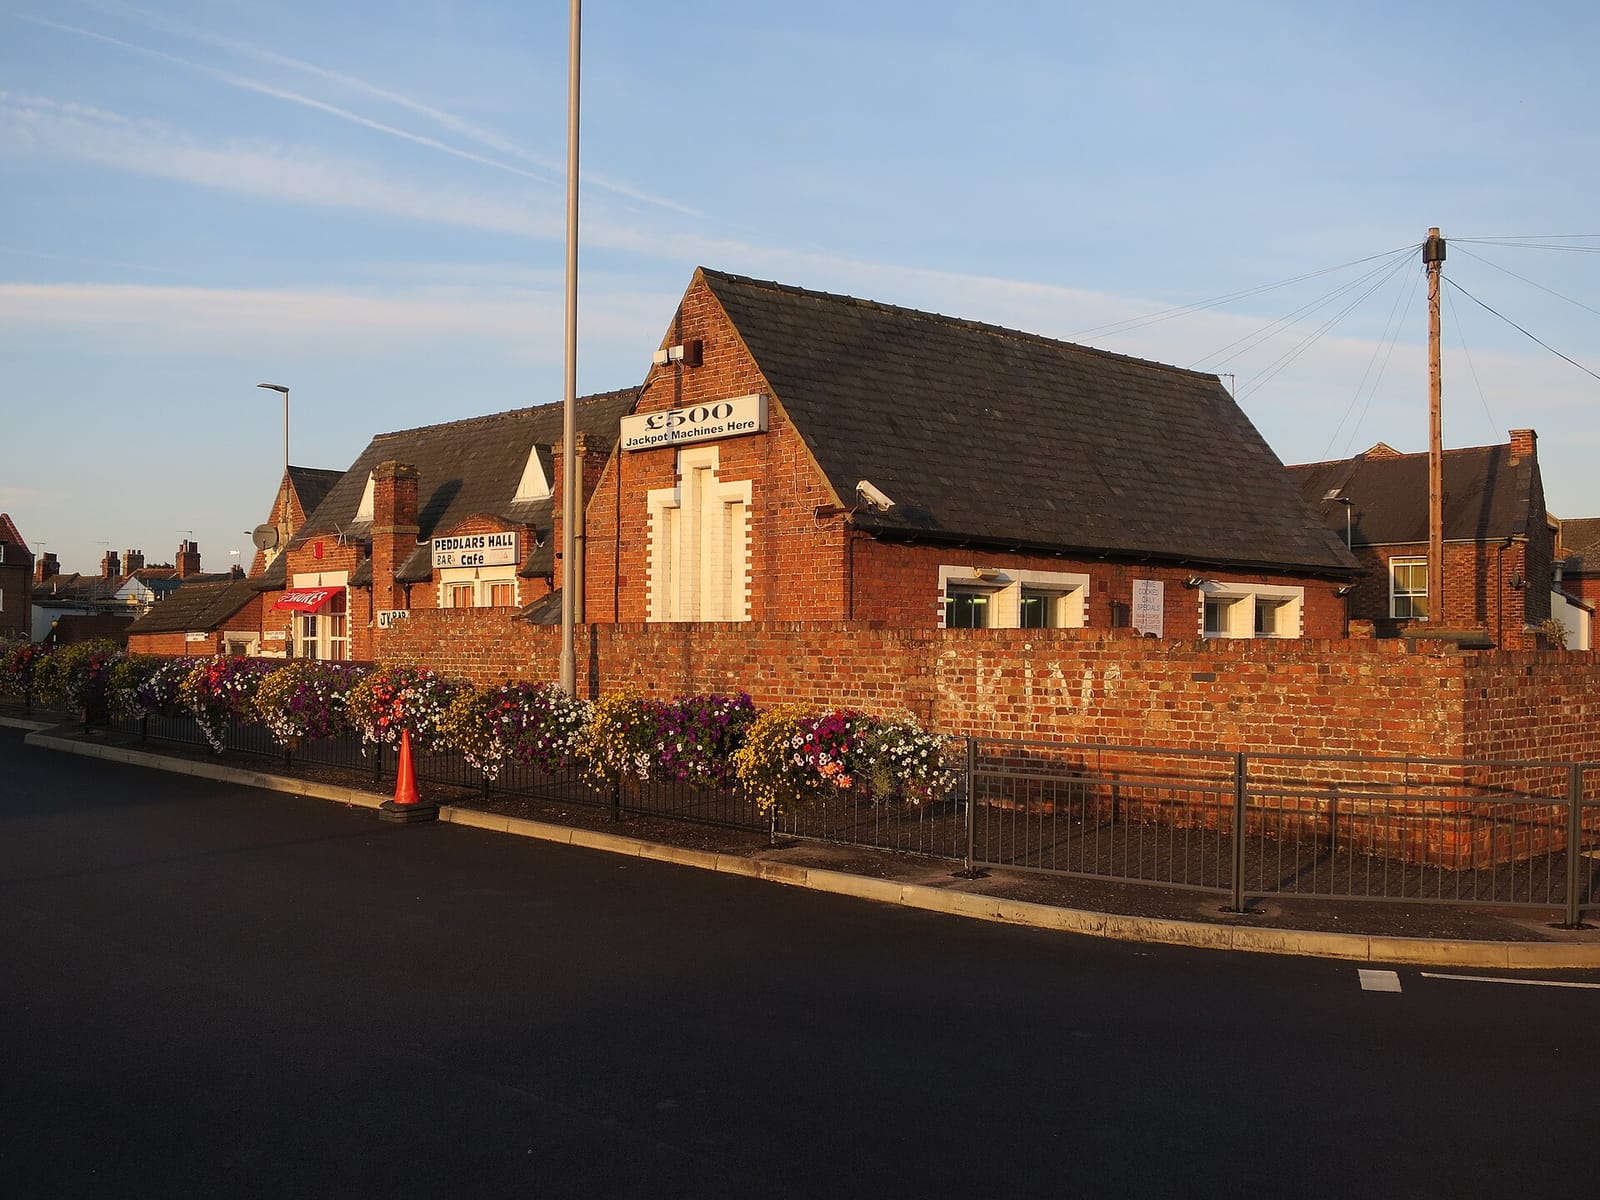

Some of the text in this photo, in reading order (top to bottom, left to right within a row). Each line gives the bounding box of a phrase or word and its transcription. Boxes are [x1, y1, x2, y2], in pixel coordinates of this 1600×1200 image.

[645, 403, 733, 431] £500
[626, 421, 755, 446] Jackpot Machines Here
[434, 534, 513, 551] PEDDLARS HALL
